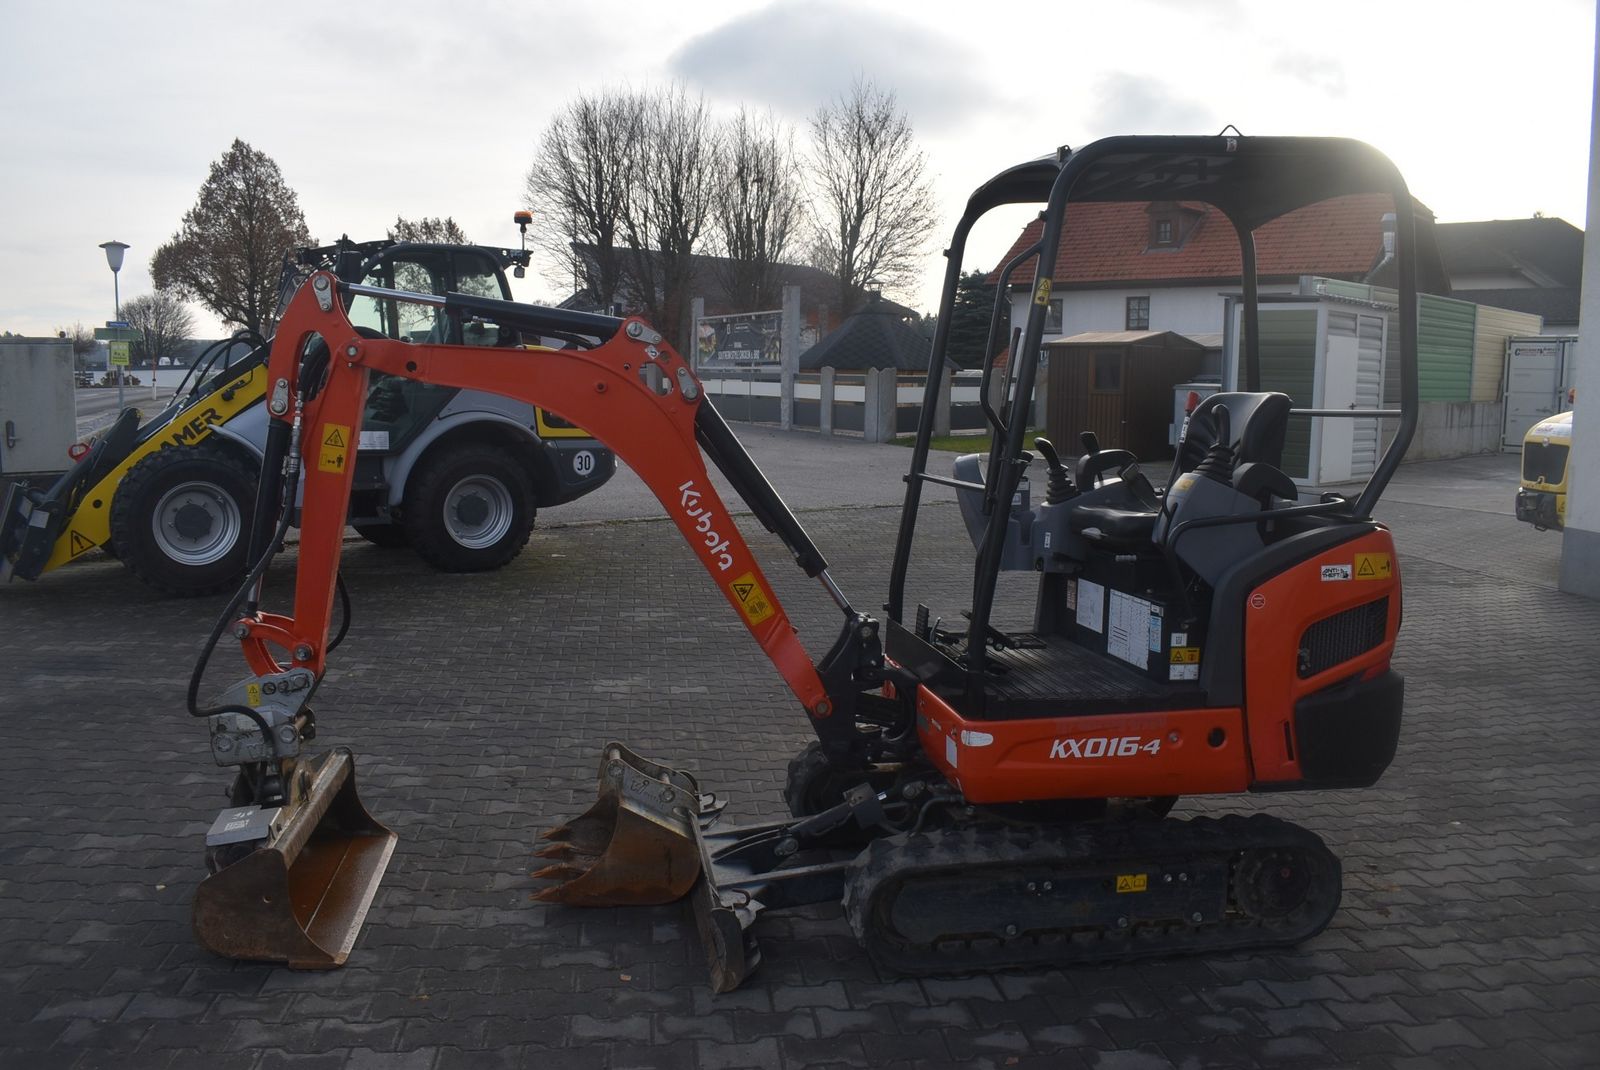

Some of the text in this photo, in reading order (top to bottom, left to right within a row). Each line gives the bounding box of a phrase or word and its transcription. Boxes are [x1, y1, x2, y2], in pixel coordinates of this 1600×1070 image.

[159, 408, 223, 447] AMER
[577, 454, 591, 471] 30
[679, 480, 733, 571] Kubota
